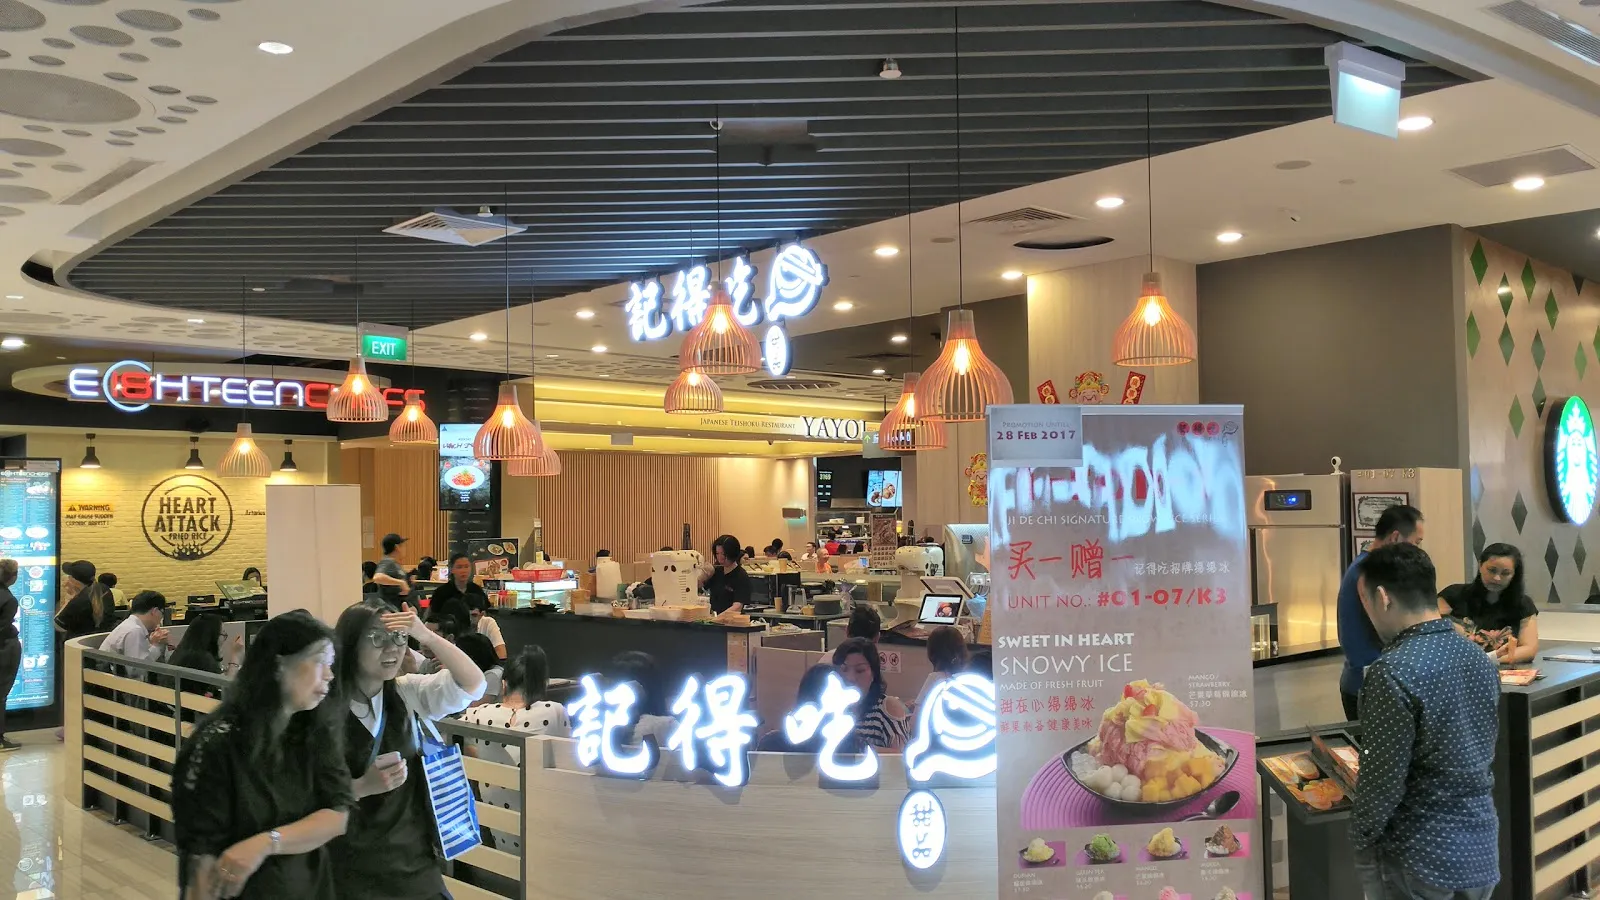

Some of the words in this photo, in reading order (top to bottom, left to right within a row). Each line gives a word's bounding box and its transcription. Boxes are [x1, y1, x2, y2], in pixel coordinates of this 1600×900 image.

[371, 341, 396, 356] EXIT
[700, 417, 729, 426] JAPANESE
[730, 418, 760, 427] TEISHOKU
[761, 420, 796, 429] RESTAURANT
[801, 416, 867, 440] YAYOI
[996, 430, 1014, 440] 28
[1018, 430, 1038, 440] FEB
[1041, 430, 1076, 440] 2017
[78, 504, 111, 512] WARNING
[159, 496, 217, 514] HEART
[154, 514, 221, 533] ATTACK
[1007, 516, 1016, 526] JI
[1019, 515, 1034, 525] DE
[1036, 515, 1058, 525] CHI
[168, 532, 190, 541] FRIED
[191, 532, 207, 541] RICE
[1007, 538, 1134, 580] 买一赠一
[1008, 595, 1050, 609] UNIT
[1097, 587, 1228, 608] #01-07/K3
[997, 634, 1051, 649] SWEET
[1054, 634, 1073, 647] IN
[1078, 632, 1135, 647] HEART
[1000, 654, 1091, 676] SNOWY
[1099, 652, 1133, 673] ICE
[999, 681, 1028, 691] MADE
[1029, 681, 1043, 690] OF
[1045, 680, 1074, 689] FRESH
[1076, 679, 1104, 688] FRUIT
[567, 671, 879, 787] 記得吃
